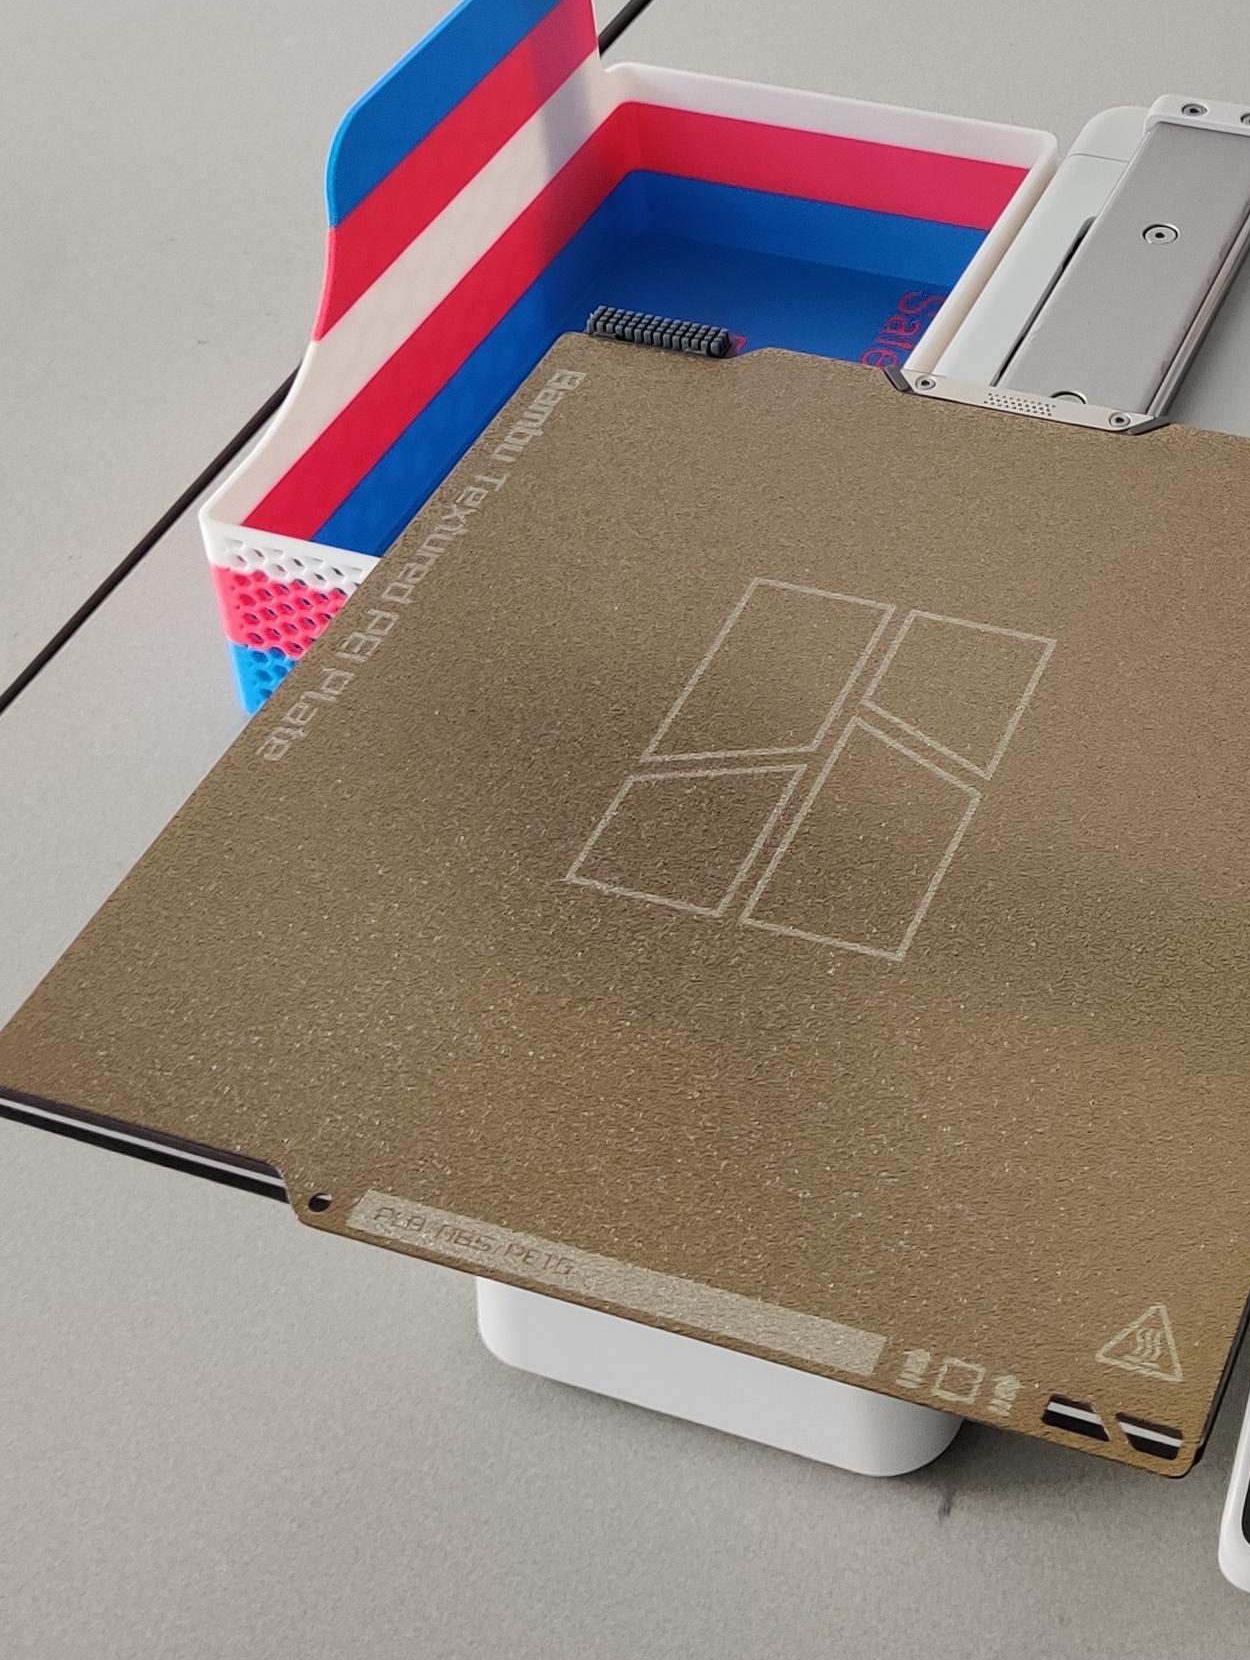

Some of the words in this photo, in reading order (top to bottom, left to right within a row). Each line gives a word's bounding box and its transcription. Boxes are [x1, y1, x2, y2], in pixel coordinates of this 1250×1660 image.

[492, 369, 587, 463] Bambu
[382, 471, 509, 605] Textured
[333, 608, 400, 663] PEI
[256, 667, 355, 762] Plate
